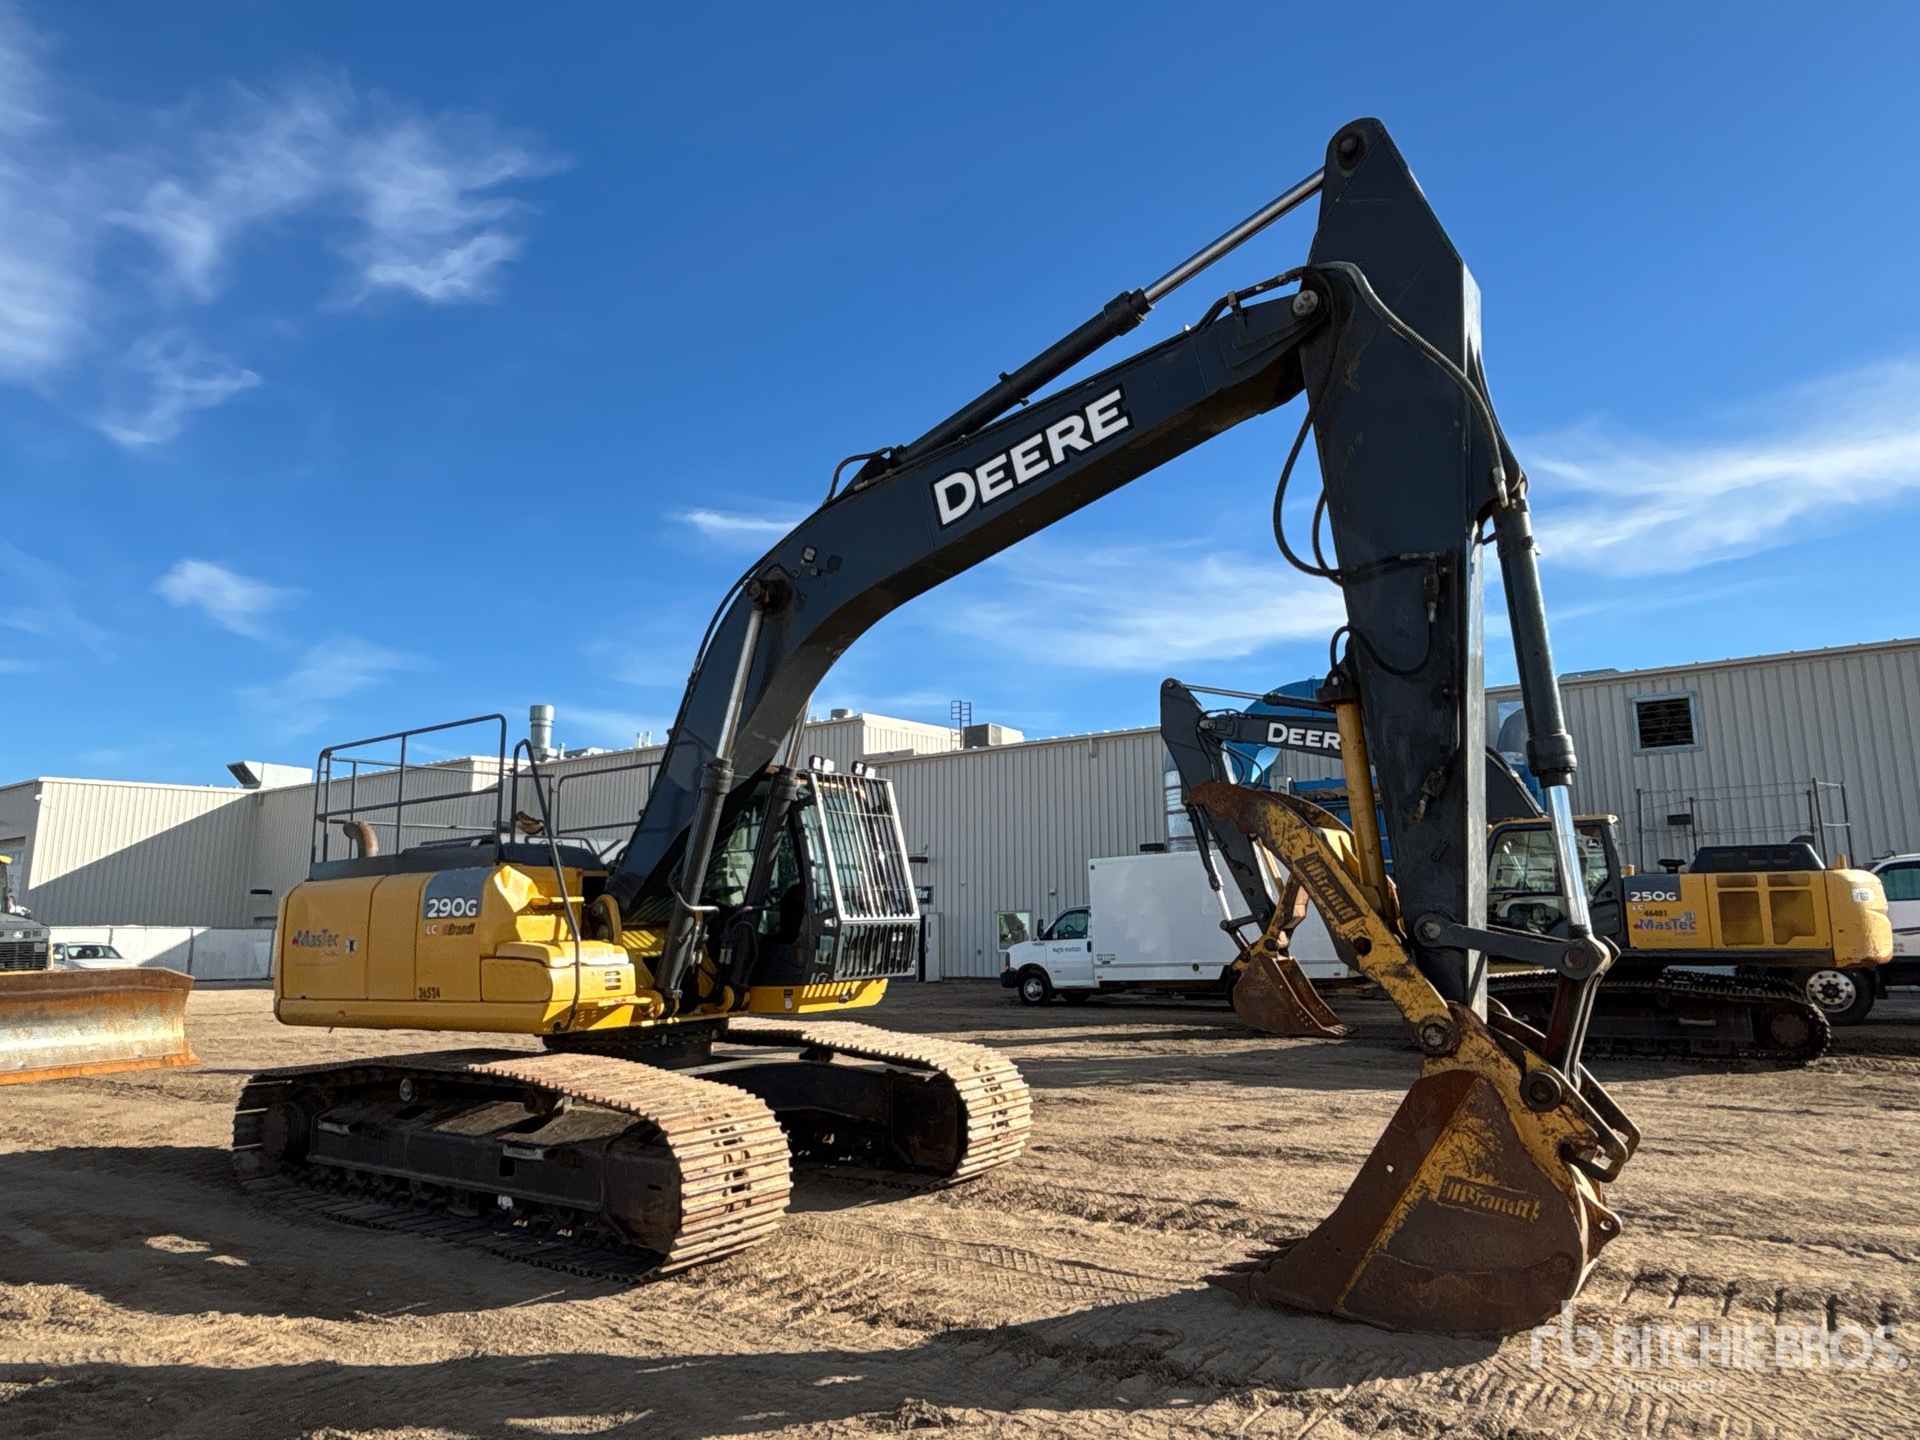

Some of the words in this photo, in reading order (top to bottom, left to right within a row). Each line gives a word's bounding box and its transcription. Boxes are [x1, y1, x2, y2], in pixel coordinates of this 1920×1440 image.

[933, 388, 1129, 526] DEERE
[1267, 722, 1342, 750] DEER
[1630, 890, 1677, 902] 250G
[427, 897, 478, 918] 290G
[426, 924, 438, 935] LC
[1638, 918, 1697, 930] MasTec
[296, 928, 339, 948] MasTec
